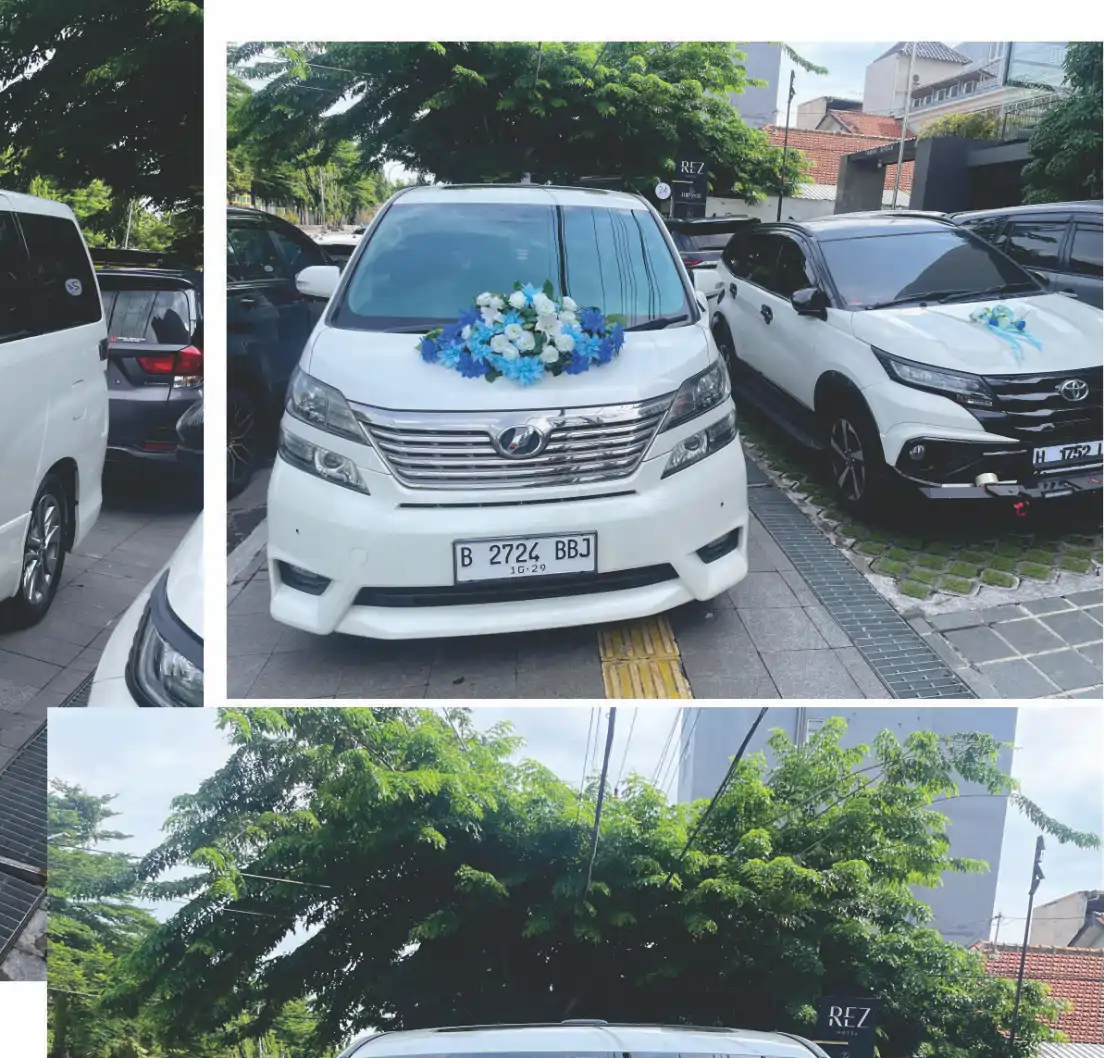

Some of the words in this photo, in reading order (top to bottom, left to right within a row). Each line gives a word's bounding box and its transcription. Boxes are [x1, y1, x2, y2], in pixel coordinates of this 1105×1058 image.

[680, 160, 705, 175] REZ
[1036, 449, 1045, 464] H
[460, 547, 473, 568] B
[489, 542, 540, 566] 2724
[555, 538, 591, 560] BBJ
[828, 1005, 871, 1029] REZ
